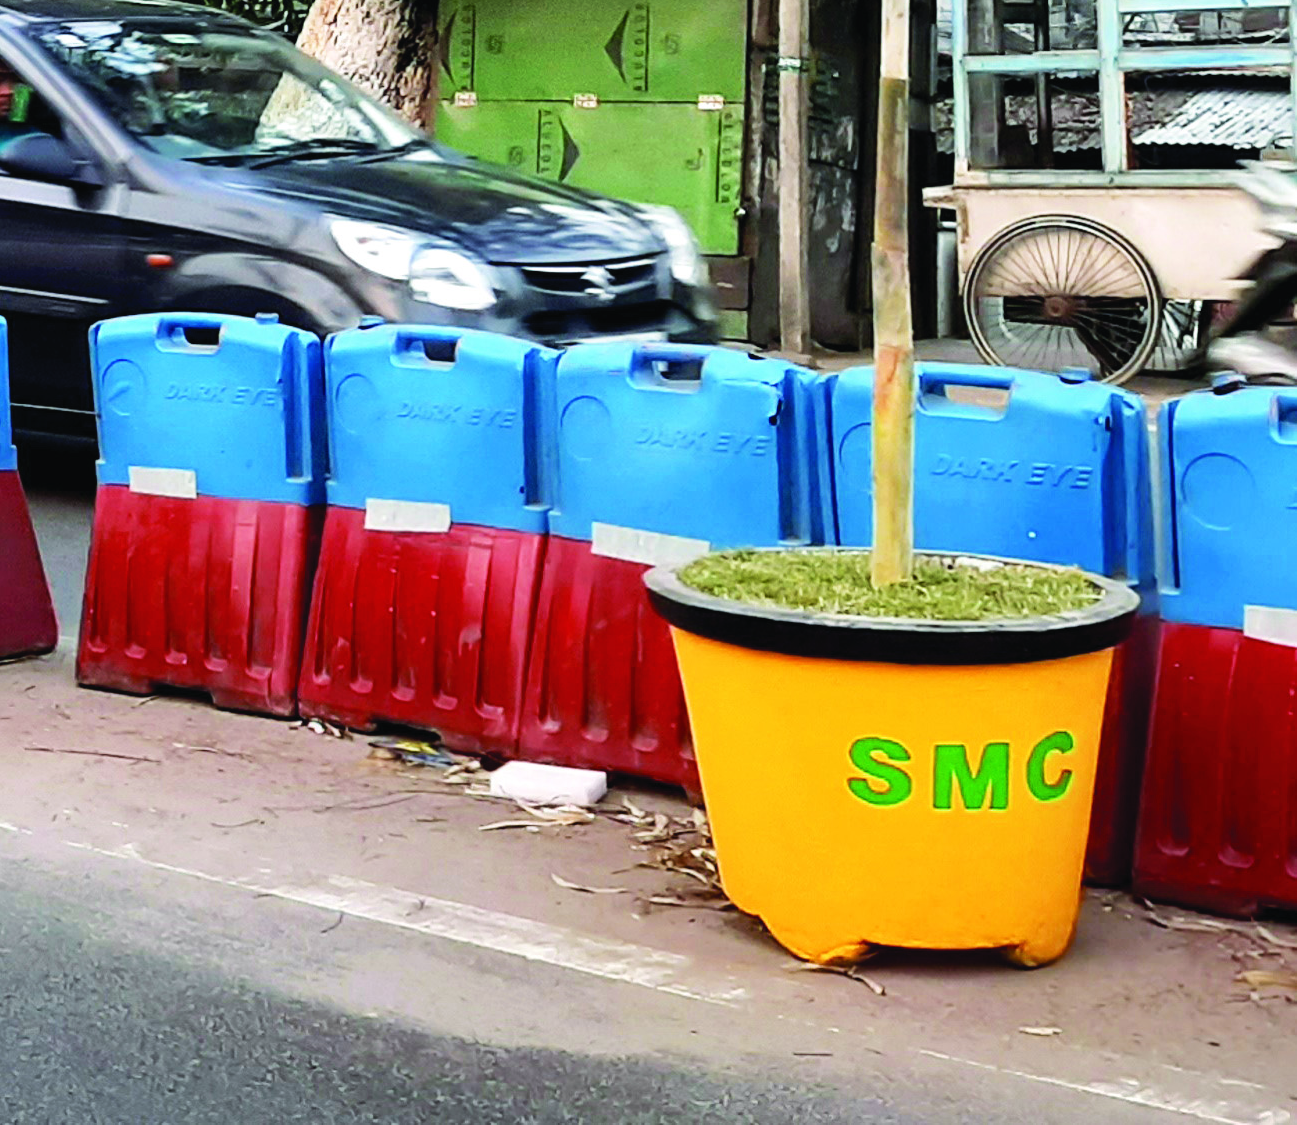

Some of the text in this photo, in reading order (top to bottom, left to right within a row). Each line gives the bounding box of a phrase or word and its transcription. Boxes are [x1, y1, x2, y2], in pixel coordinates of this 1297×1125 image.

[540, 109, 553, 174] ALUCOL
[1024, 461, 1094, 489] EYE
[847, 730, 1075, 811] SMC
